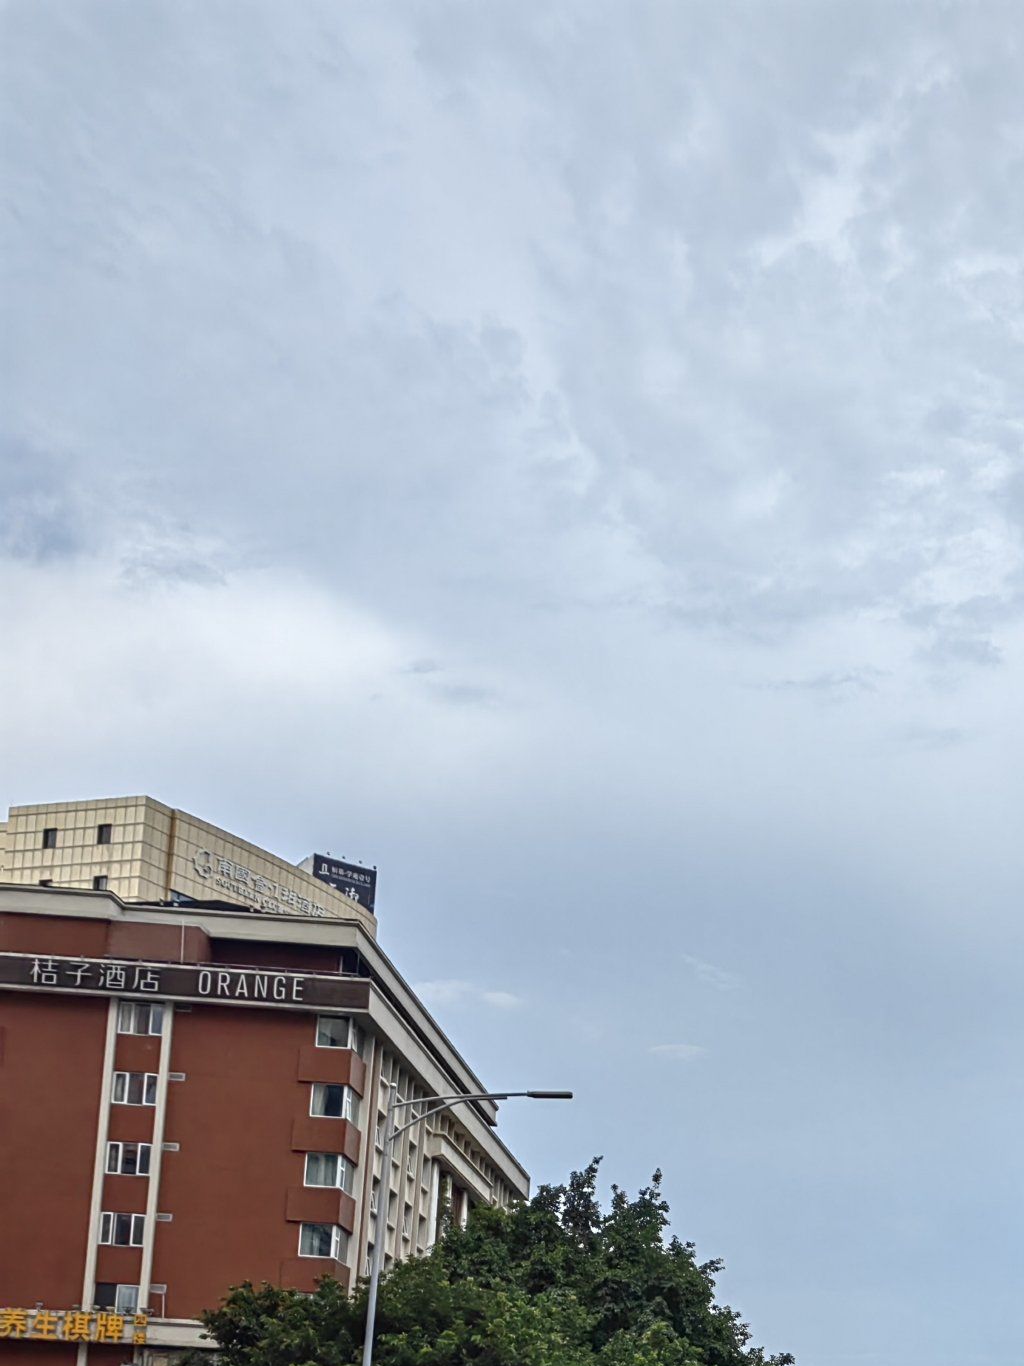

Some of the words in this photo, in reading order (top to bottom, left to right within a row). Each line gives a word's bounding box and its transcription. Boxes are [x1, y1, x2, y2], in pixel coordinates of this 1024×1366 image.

[30, 958, 161, 993] 桔子酒店
[198, 971, 305, 1000] ORANGE
[0, 1308, 125, 1342] 养生棋牌
